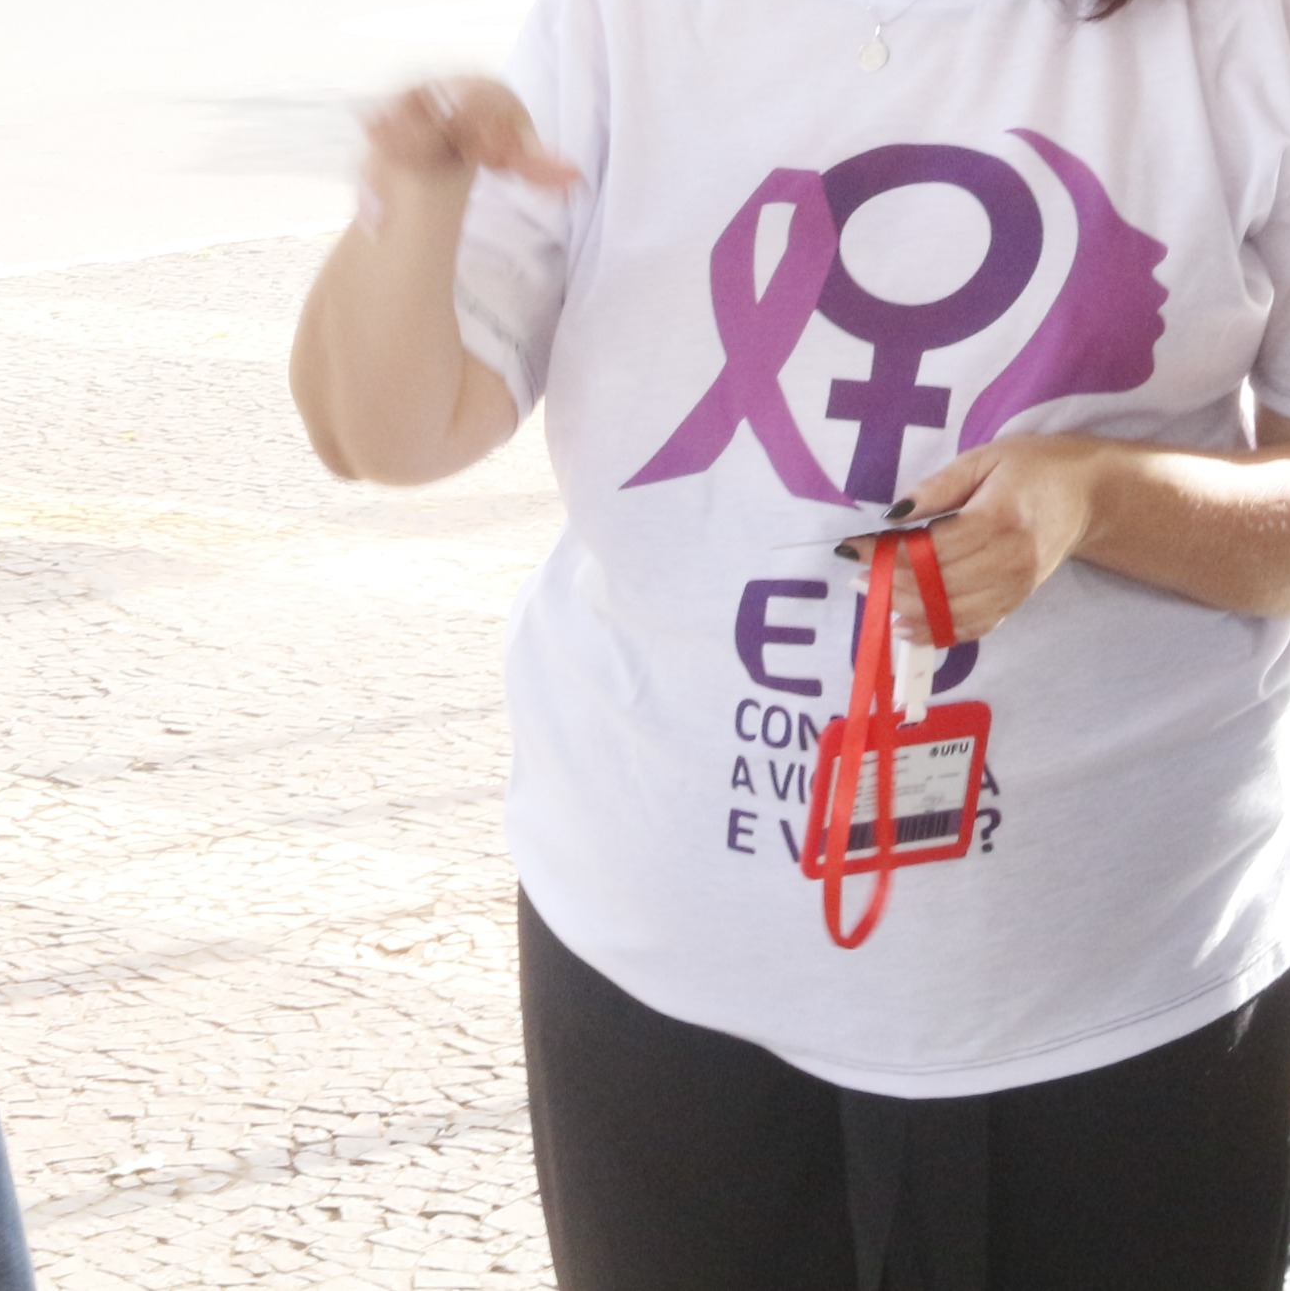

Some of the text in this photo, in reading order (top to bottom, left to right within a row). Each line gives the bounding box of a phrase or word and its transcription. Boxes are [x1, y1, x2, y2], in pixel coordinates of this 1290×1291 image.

[940, 741, 970, 757] UFU
[731, 755, 756, 795] A
[727, 807, 758, 855] E
